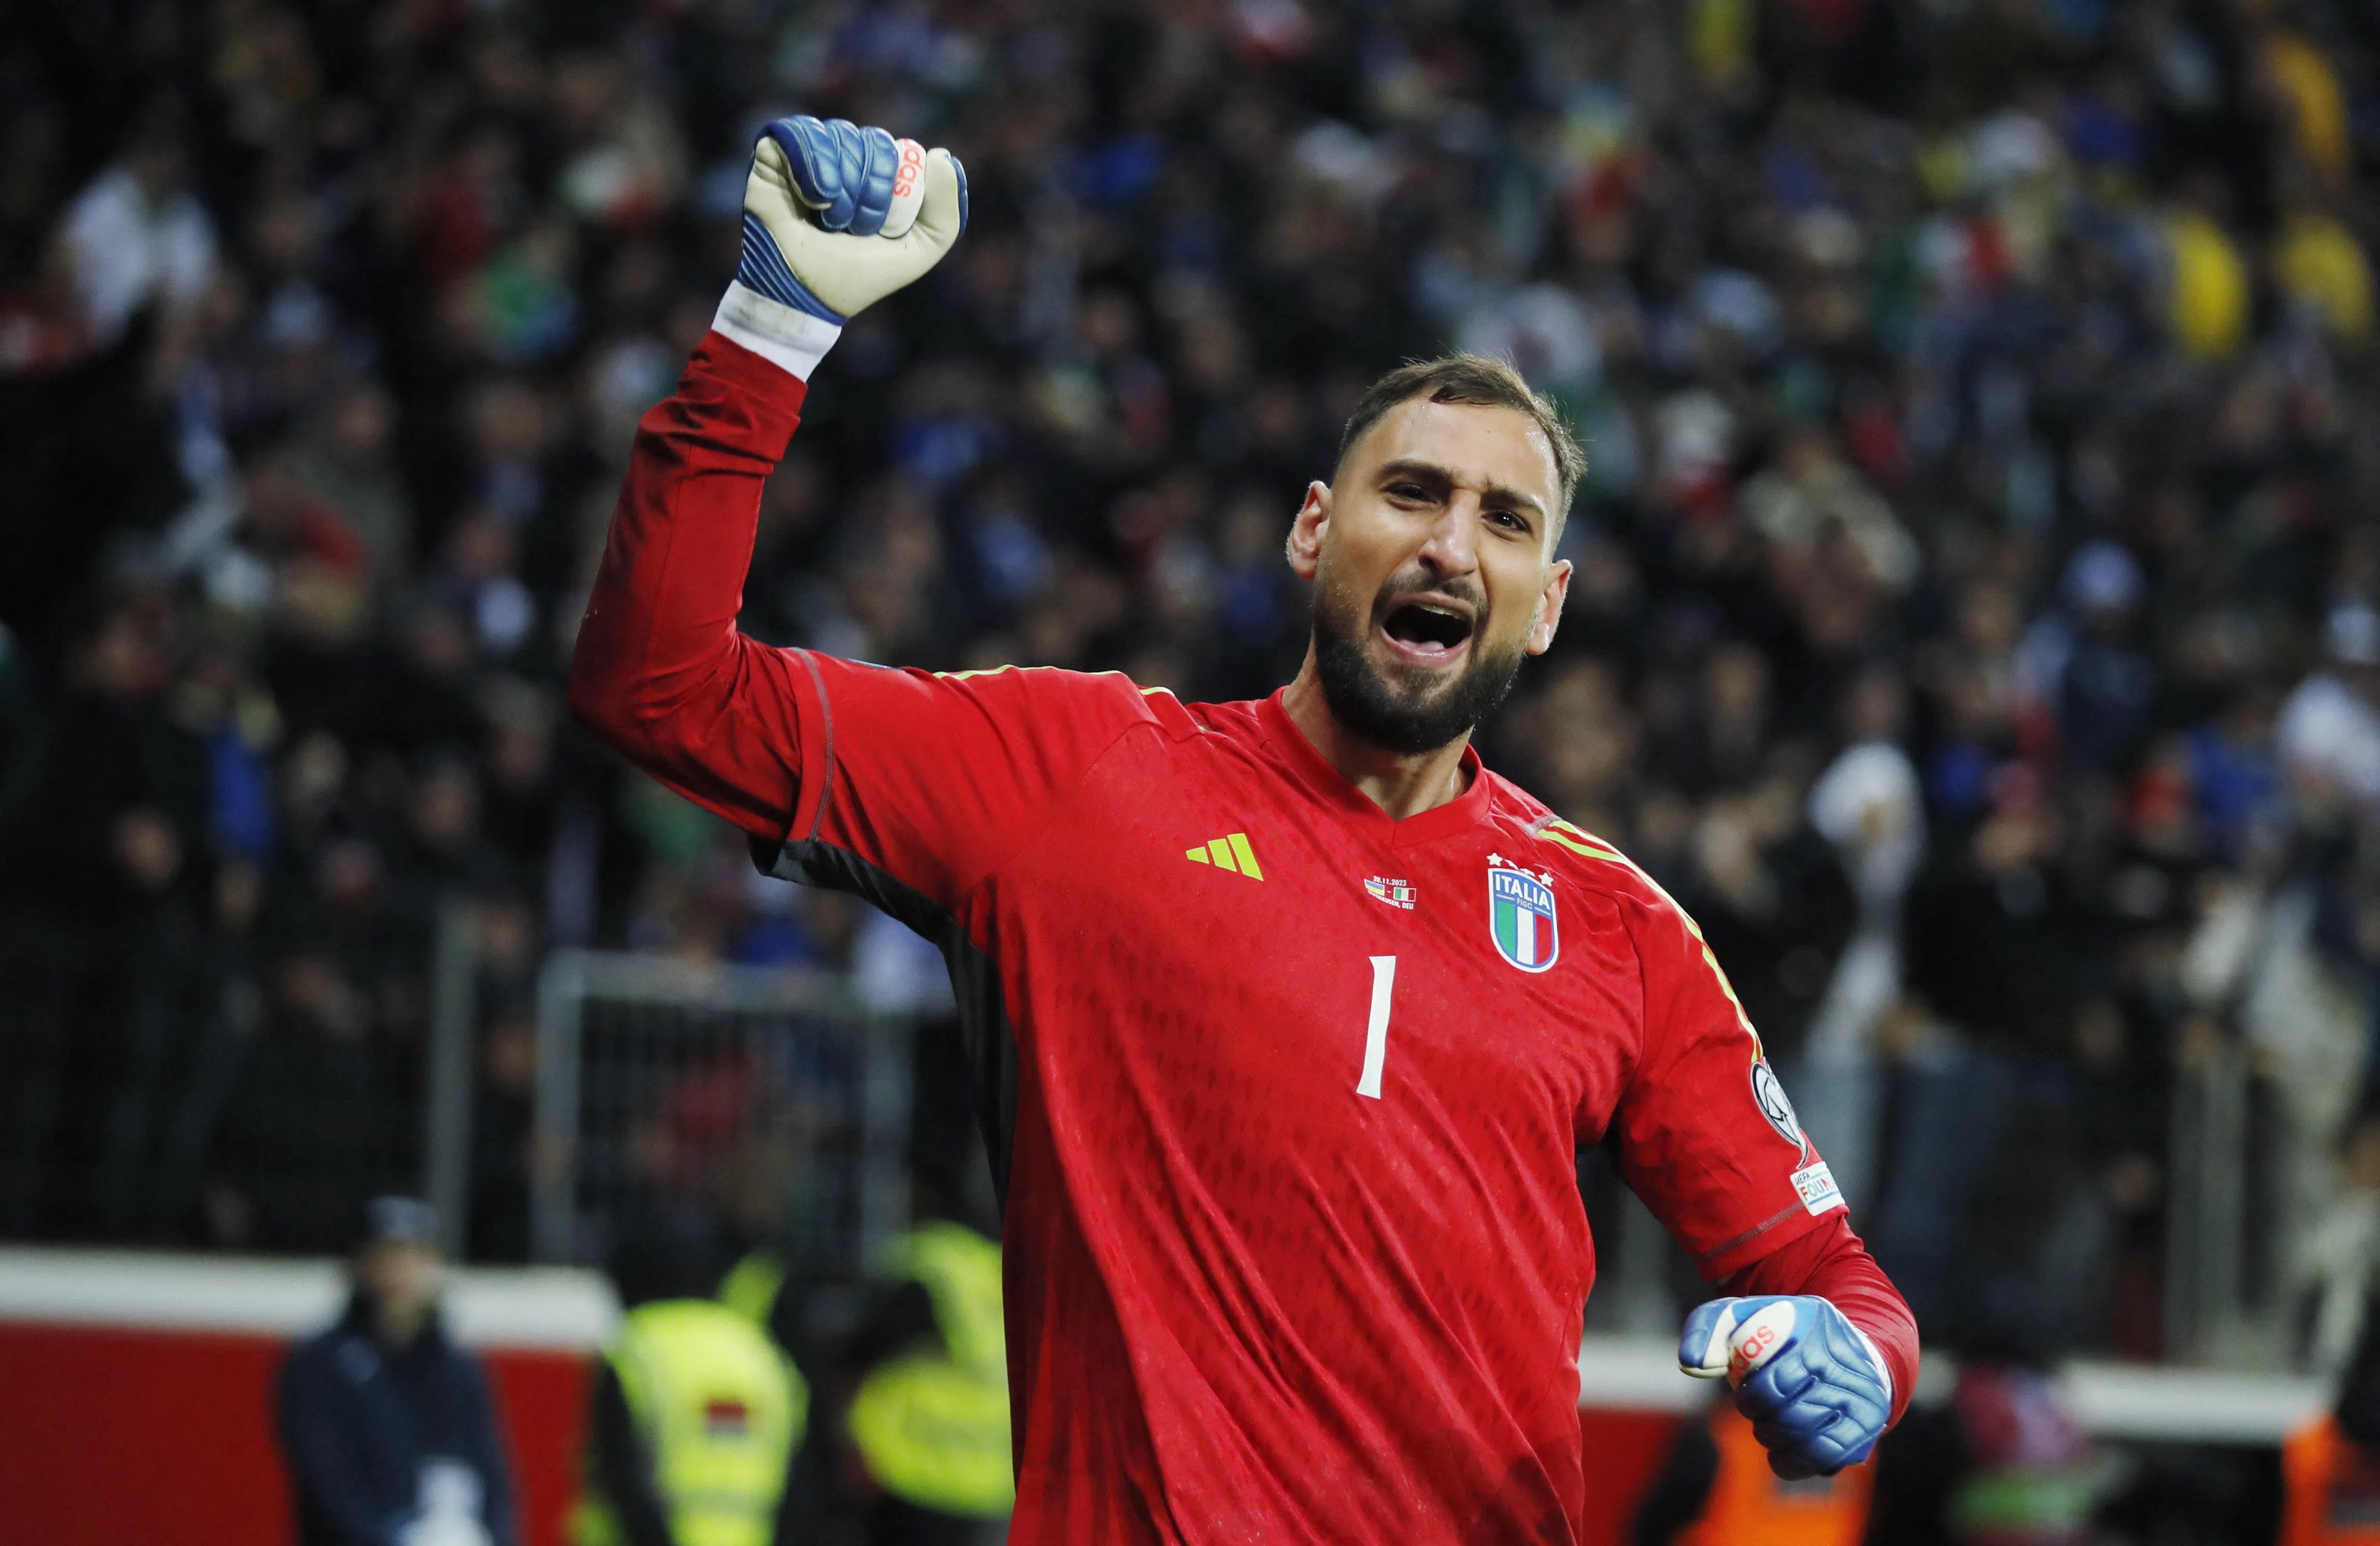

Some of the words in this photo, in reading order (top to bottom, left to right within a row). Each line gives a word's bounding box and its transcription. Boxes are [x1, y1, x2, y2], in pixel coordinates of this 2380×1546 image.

[1373, 875, 1407, 887] 20.11.2023
[1495, 874, 1551, 911] ITALIA
[1516, 898, 1533, 910] FIGC
[1356, 955, 1396, 1100] 1
